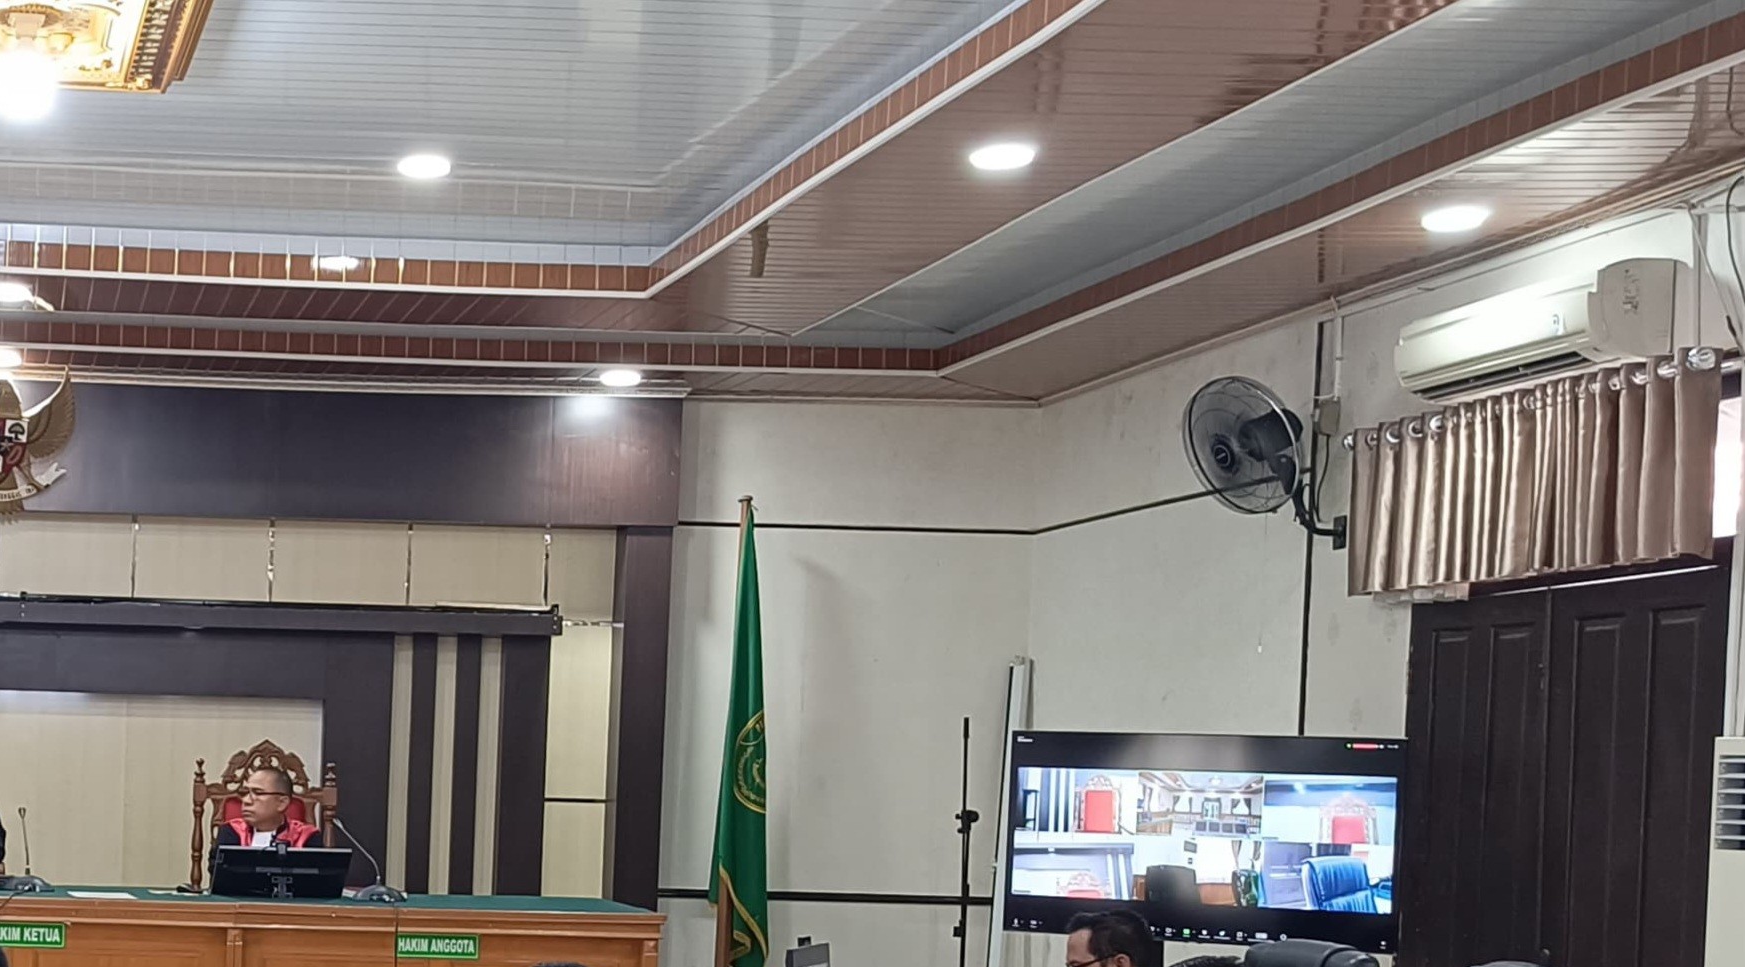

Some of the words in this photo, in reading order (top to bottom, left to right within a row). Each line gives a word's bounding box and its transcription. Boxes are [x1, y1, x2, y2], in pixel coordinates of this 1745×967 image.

[23, 927, 61, 942] KETUA
[398, 937, 429, 952] HAKIM
[430, 938, 475, 953] ANGGOTA
